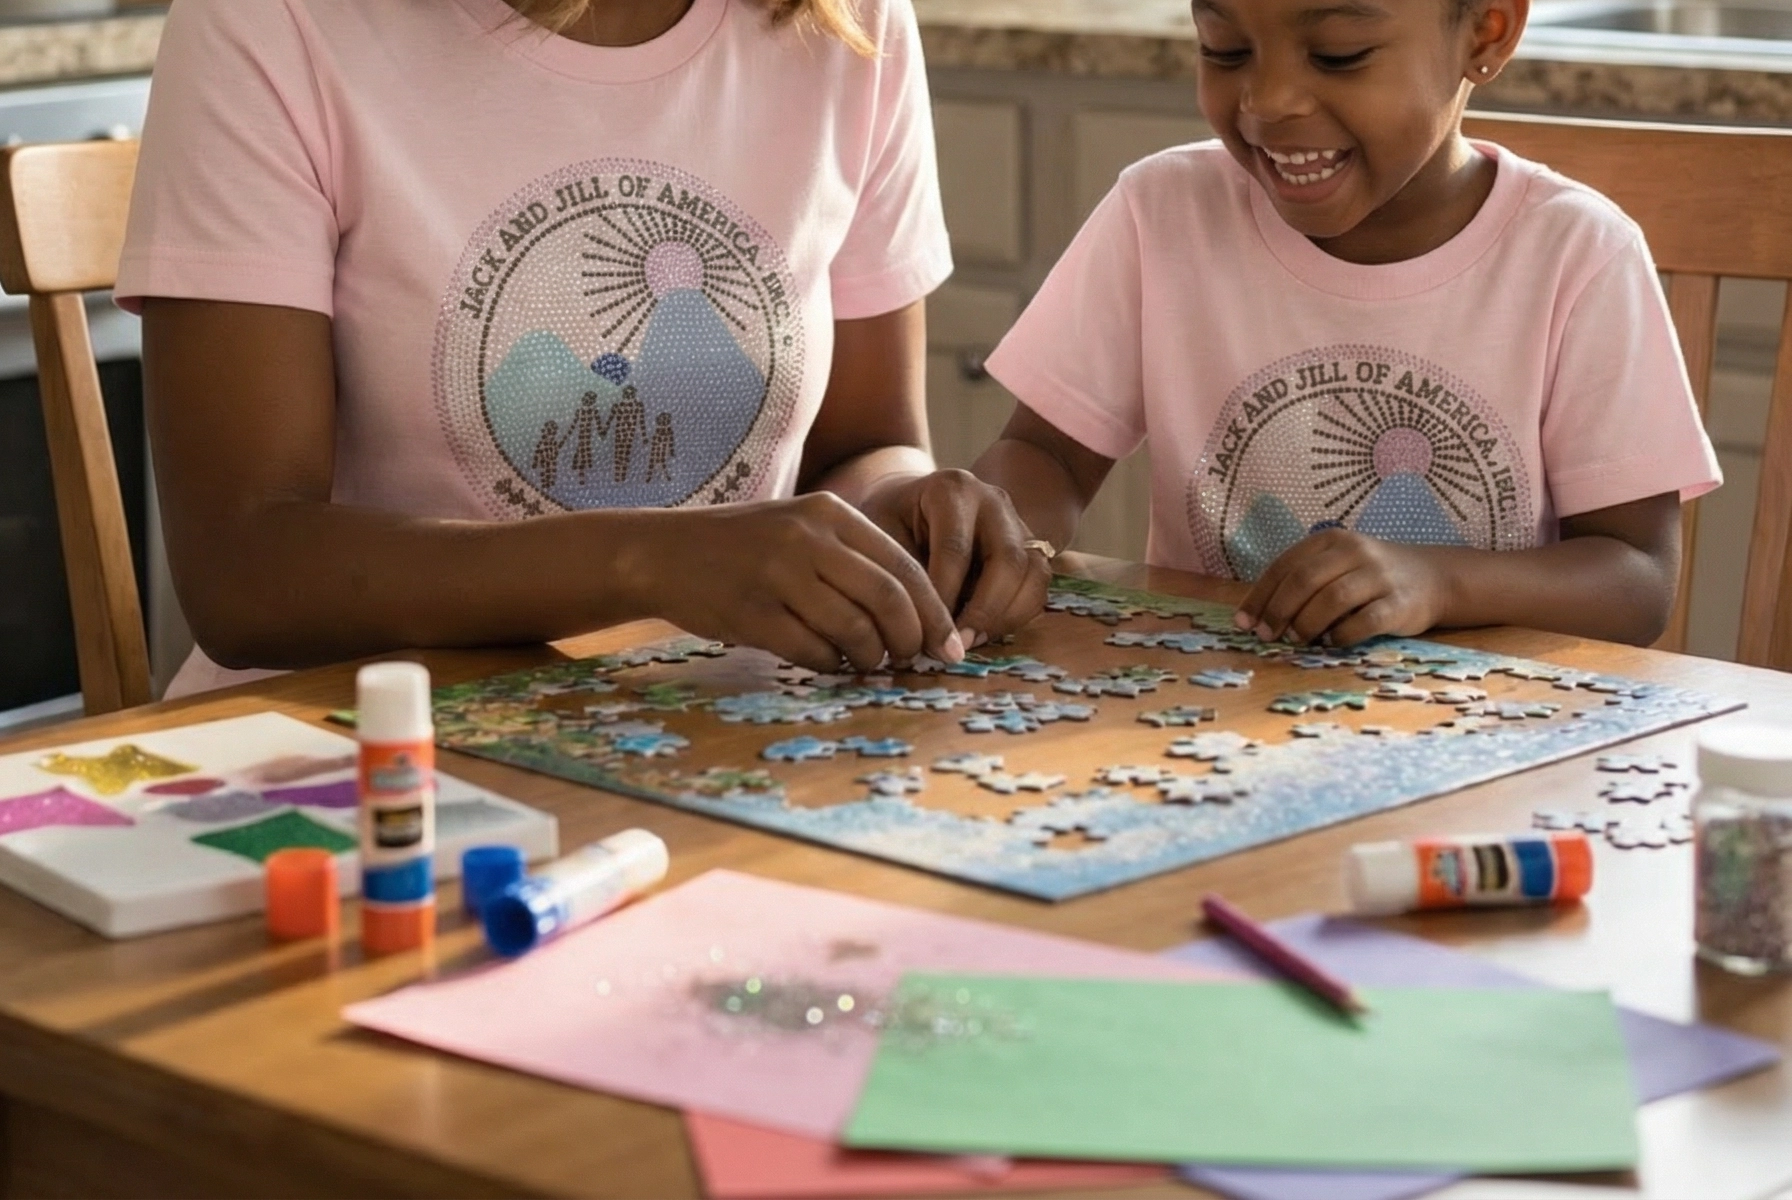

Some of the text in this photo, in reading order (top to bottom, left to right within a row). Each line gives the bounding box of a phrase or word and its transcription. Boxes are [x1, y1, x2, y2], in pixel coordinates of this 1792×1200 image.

[460, 248, 506, 319] JACK
[500, 202, 549, 252] AND
[555, 176, 609, 212] JILL
[618, 174, 651, 198] OF
[1207, 418, 1247, 484] JACK
[1242, 378, 1288, 424] AND
[1295, 362, 1347, 390] JILL
[1356, 361, 1390, 384] OF
[1394, 370, 1498, 467] AMERICA,
